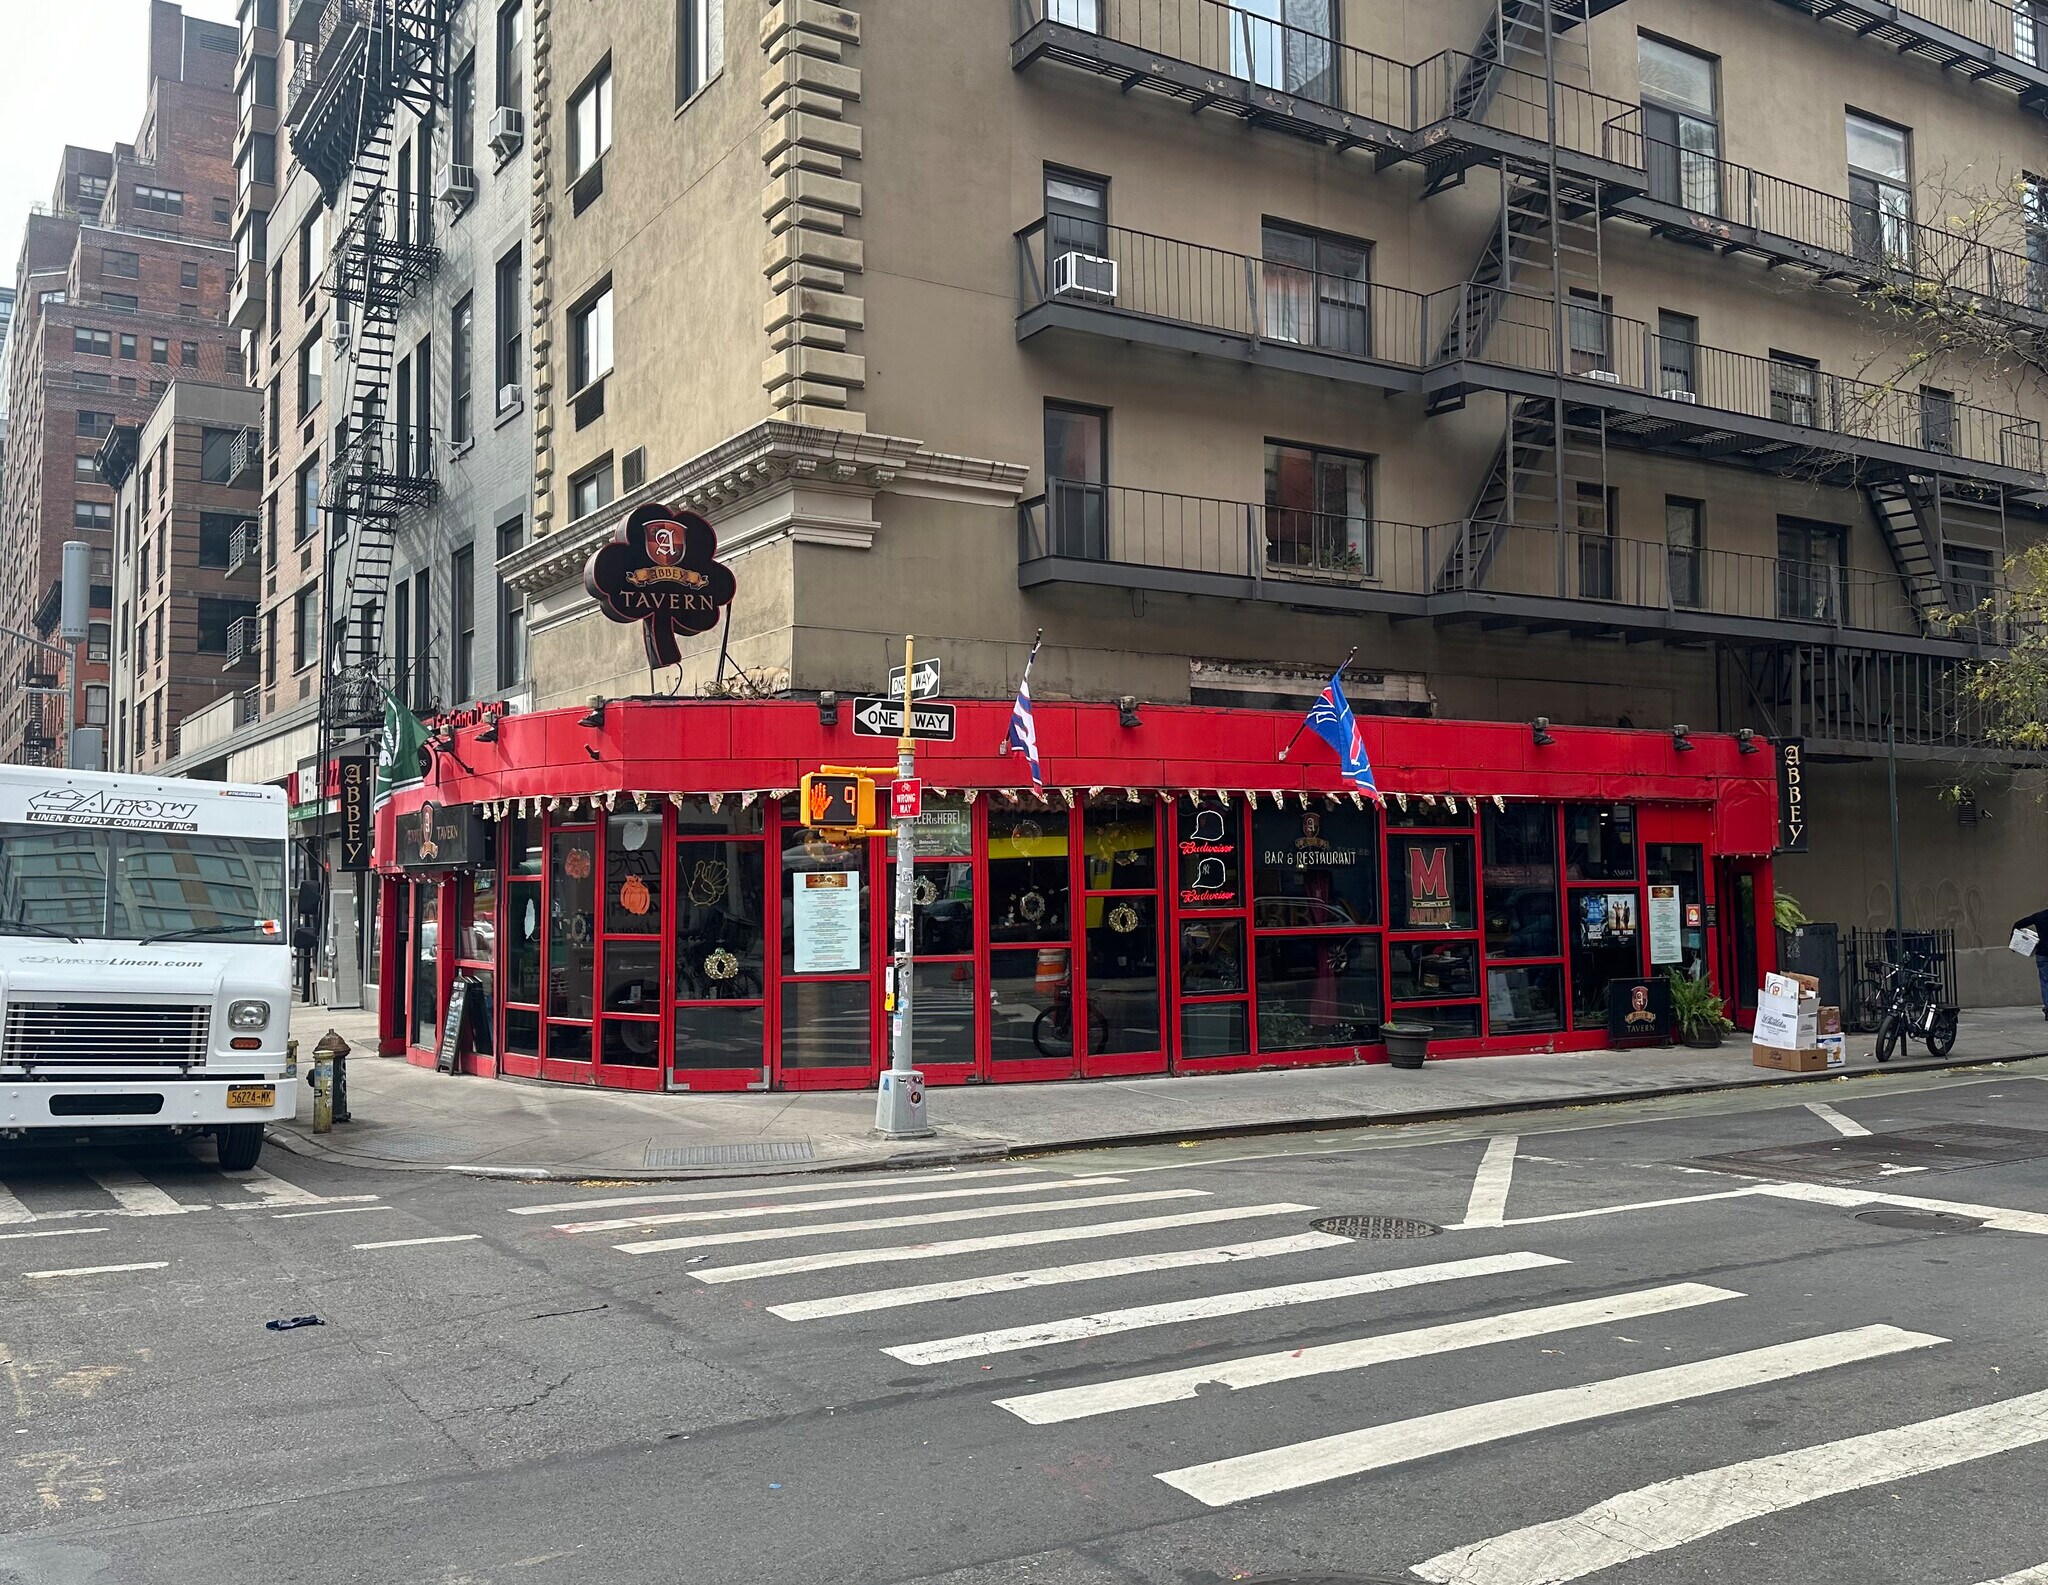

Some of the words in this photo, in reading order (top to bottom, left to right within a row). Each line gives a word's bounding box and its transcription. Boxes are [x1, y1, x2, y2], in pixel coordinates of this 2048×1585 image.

[655, 529, 676, 556] A
[650, 567, 685, 580] ABBEY
[619, 590, 714, 611] TAVERN
[915, 672, 932, 689] WAY
[868, 710, 898, 726] ONE
[914, 714, 946, 729] WAY
[844, 786, 856, 816] 9
[896, 793, 916, 803] WRONG
[1784, 745, 1804, 845] ABBEY
[344, 764, 363, 864] ABBEY
[899, 804, 912, 814] WAY
[30, 813, 64, 823] LINEN
[67, 815, 111, 826] SUPPLY
[113, 818, 170, 830] COMPANY,
[172, 822, 195, 831] INC.
[436, 824, 459, 840] TAVERN
[1179, 841, 1235, 855] Budweiser
[1264, 850, 1284, 864] BAR
[1287, 852, 1294, 865] &
[1296, 851, 1357, 865] RESTAURANT
[1408, 847, 1449, 900] M
[1180, 889, 1236, 903] Budweiser
[1626, 1024, 1655, 1033] TAVERN
